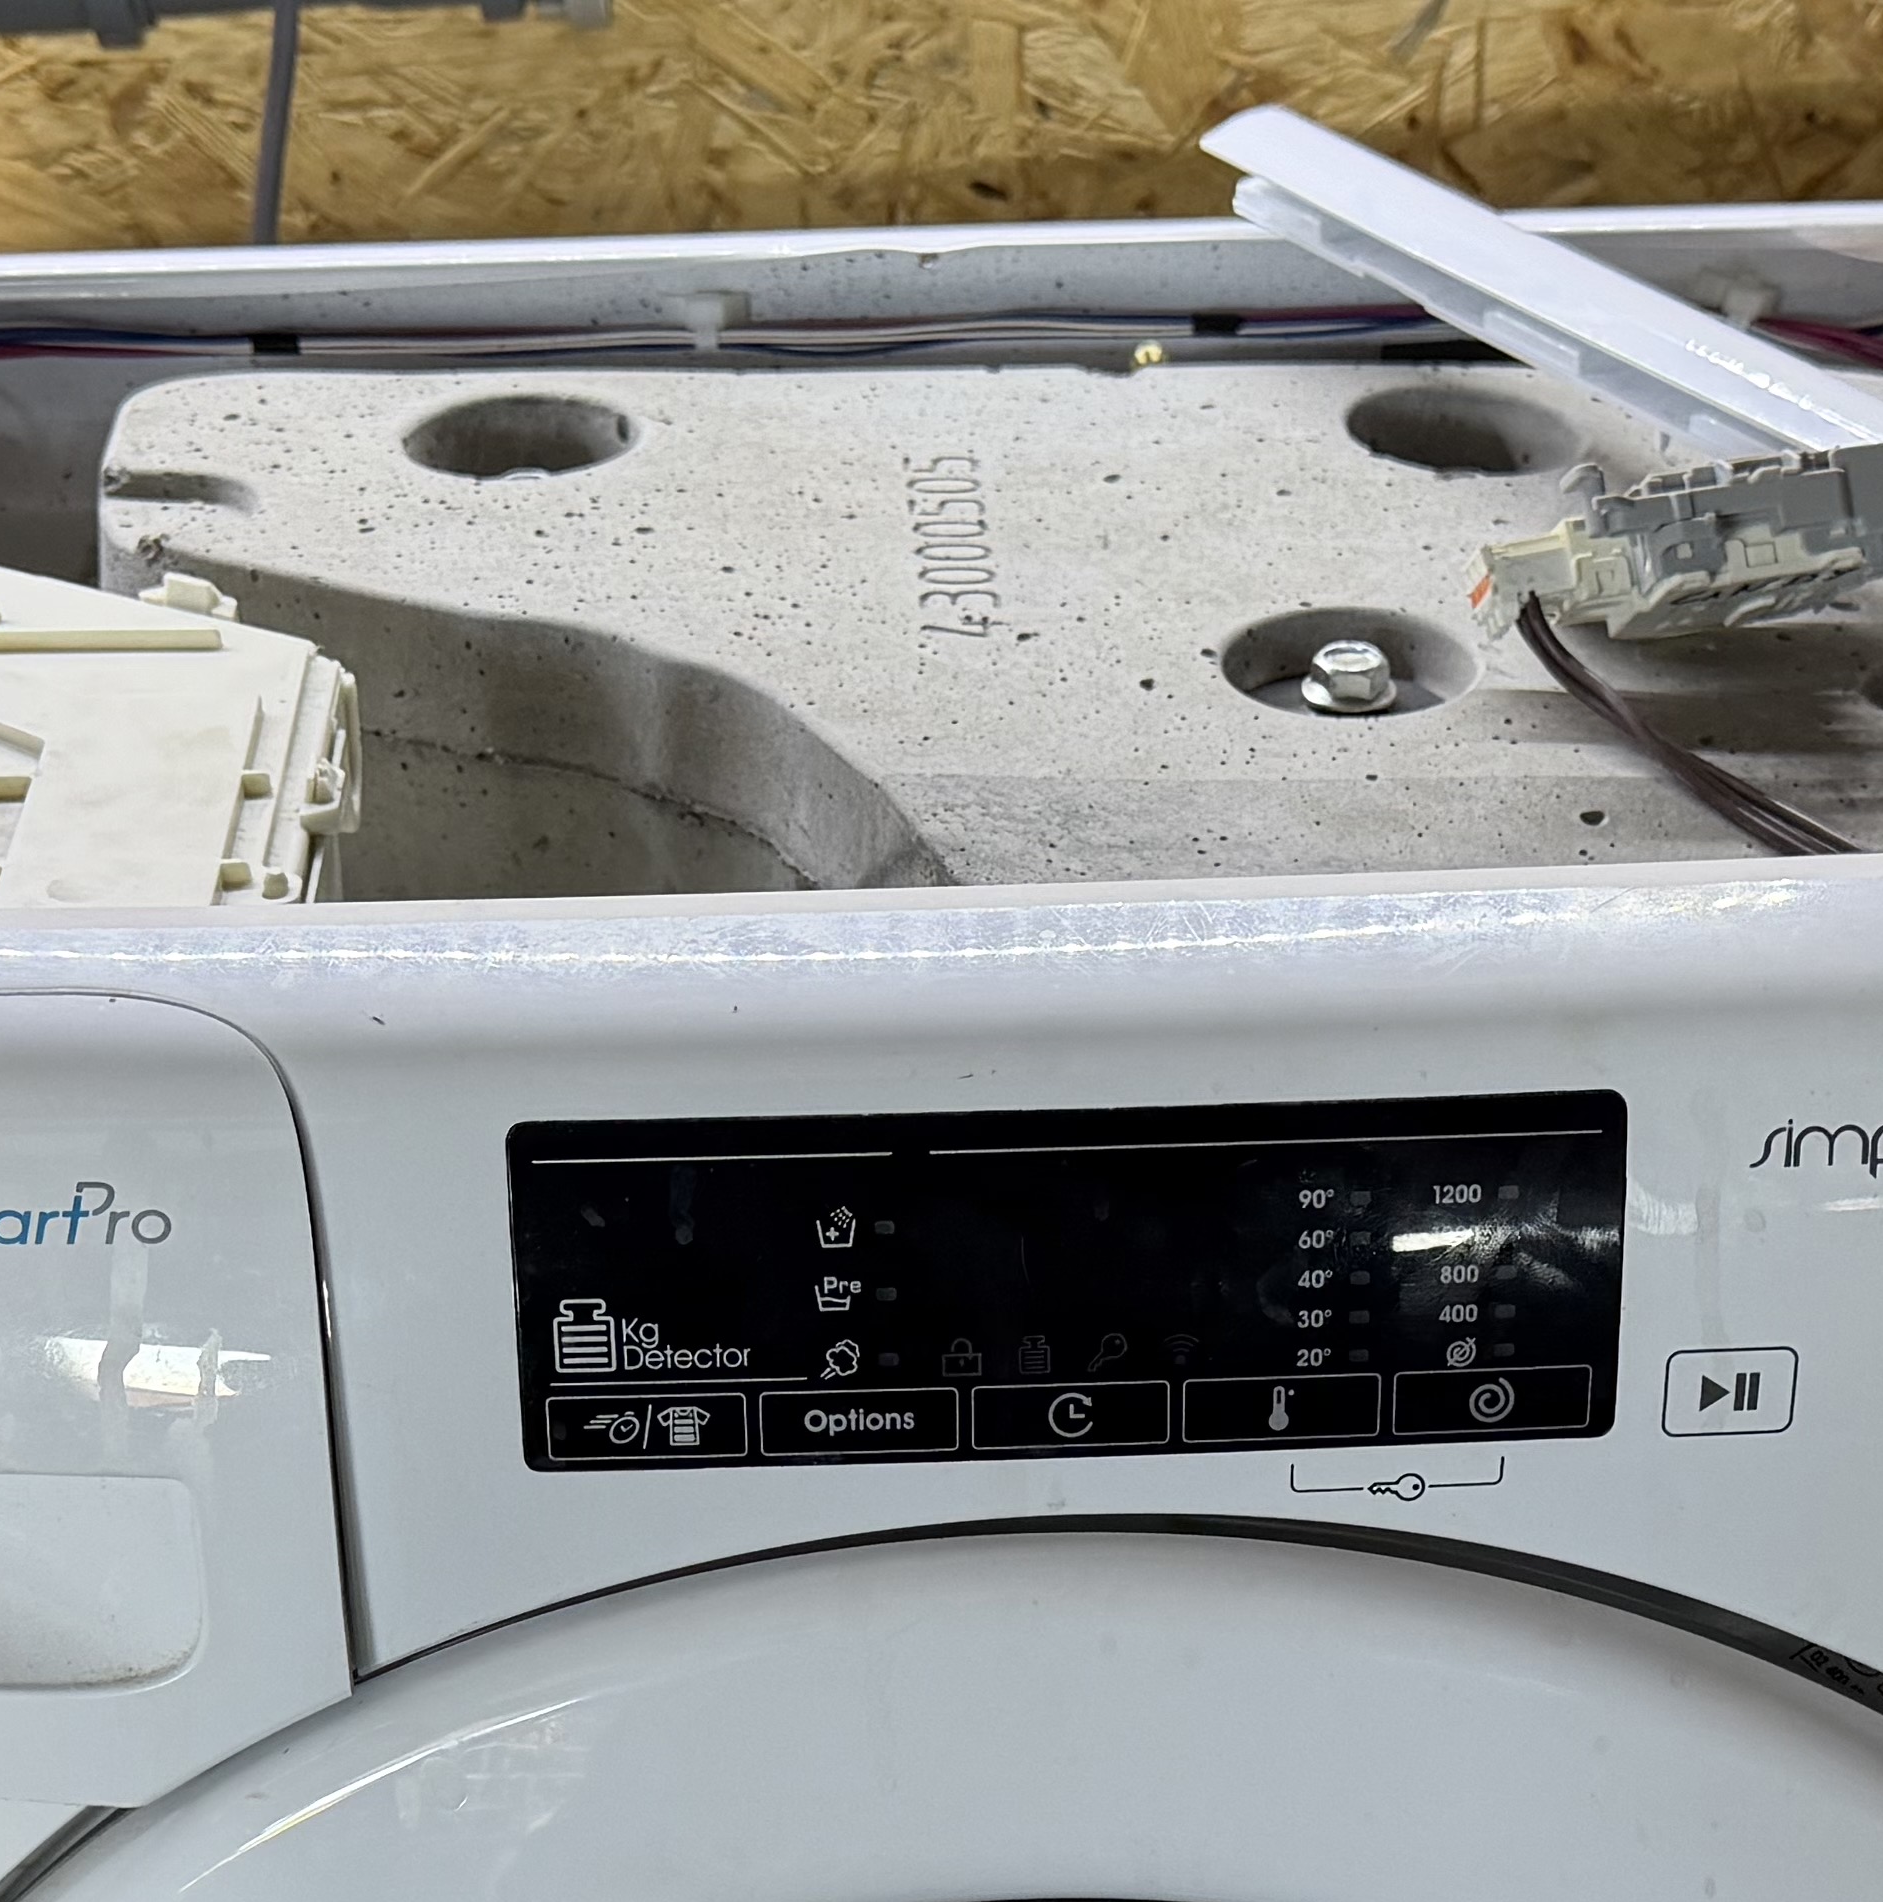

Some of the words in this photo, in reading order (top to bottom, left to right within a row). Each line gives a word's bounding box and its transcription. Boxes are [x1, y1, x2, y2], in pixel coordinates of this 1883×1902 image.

[1298, 1188, 1335, 1209] 90°
[1432, 1184, 1482, 1205] 1200
[1298, 1229, 1334, 1250] 60°
[823, 1276, 862, 1294] Pre
[1297, 1269, 1333, 1289] 40°
[1439, 1265, 1479, 1285] 800
[1297, 1309, 1332, 1329] 30°
[1438, 1304, 1479, 1324] 400
[621, 1317, 659, 1348] Kg
[623, 1343, 751, 1370] Detector
[1296, 1348, 1332, 1368] 20°
[803, 1408, 916, 1436] Options
